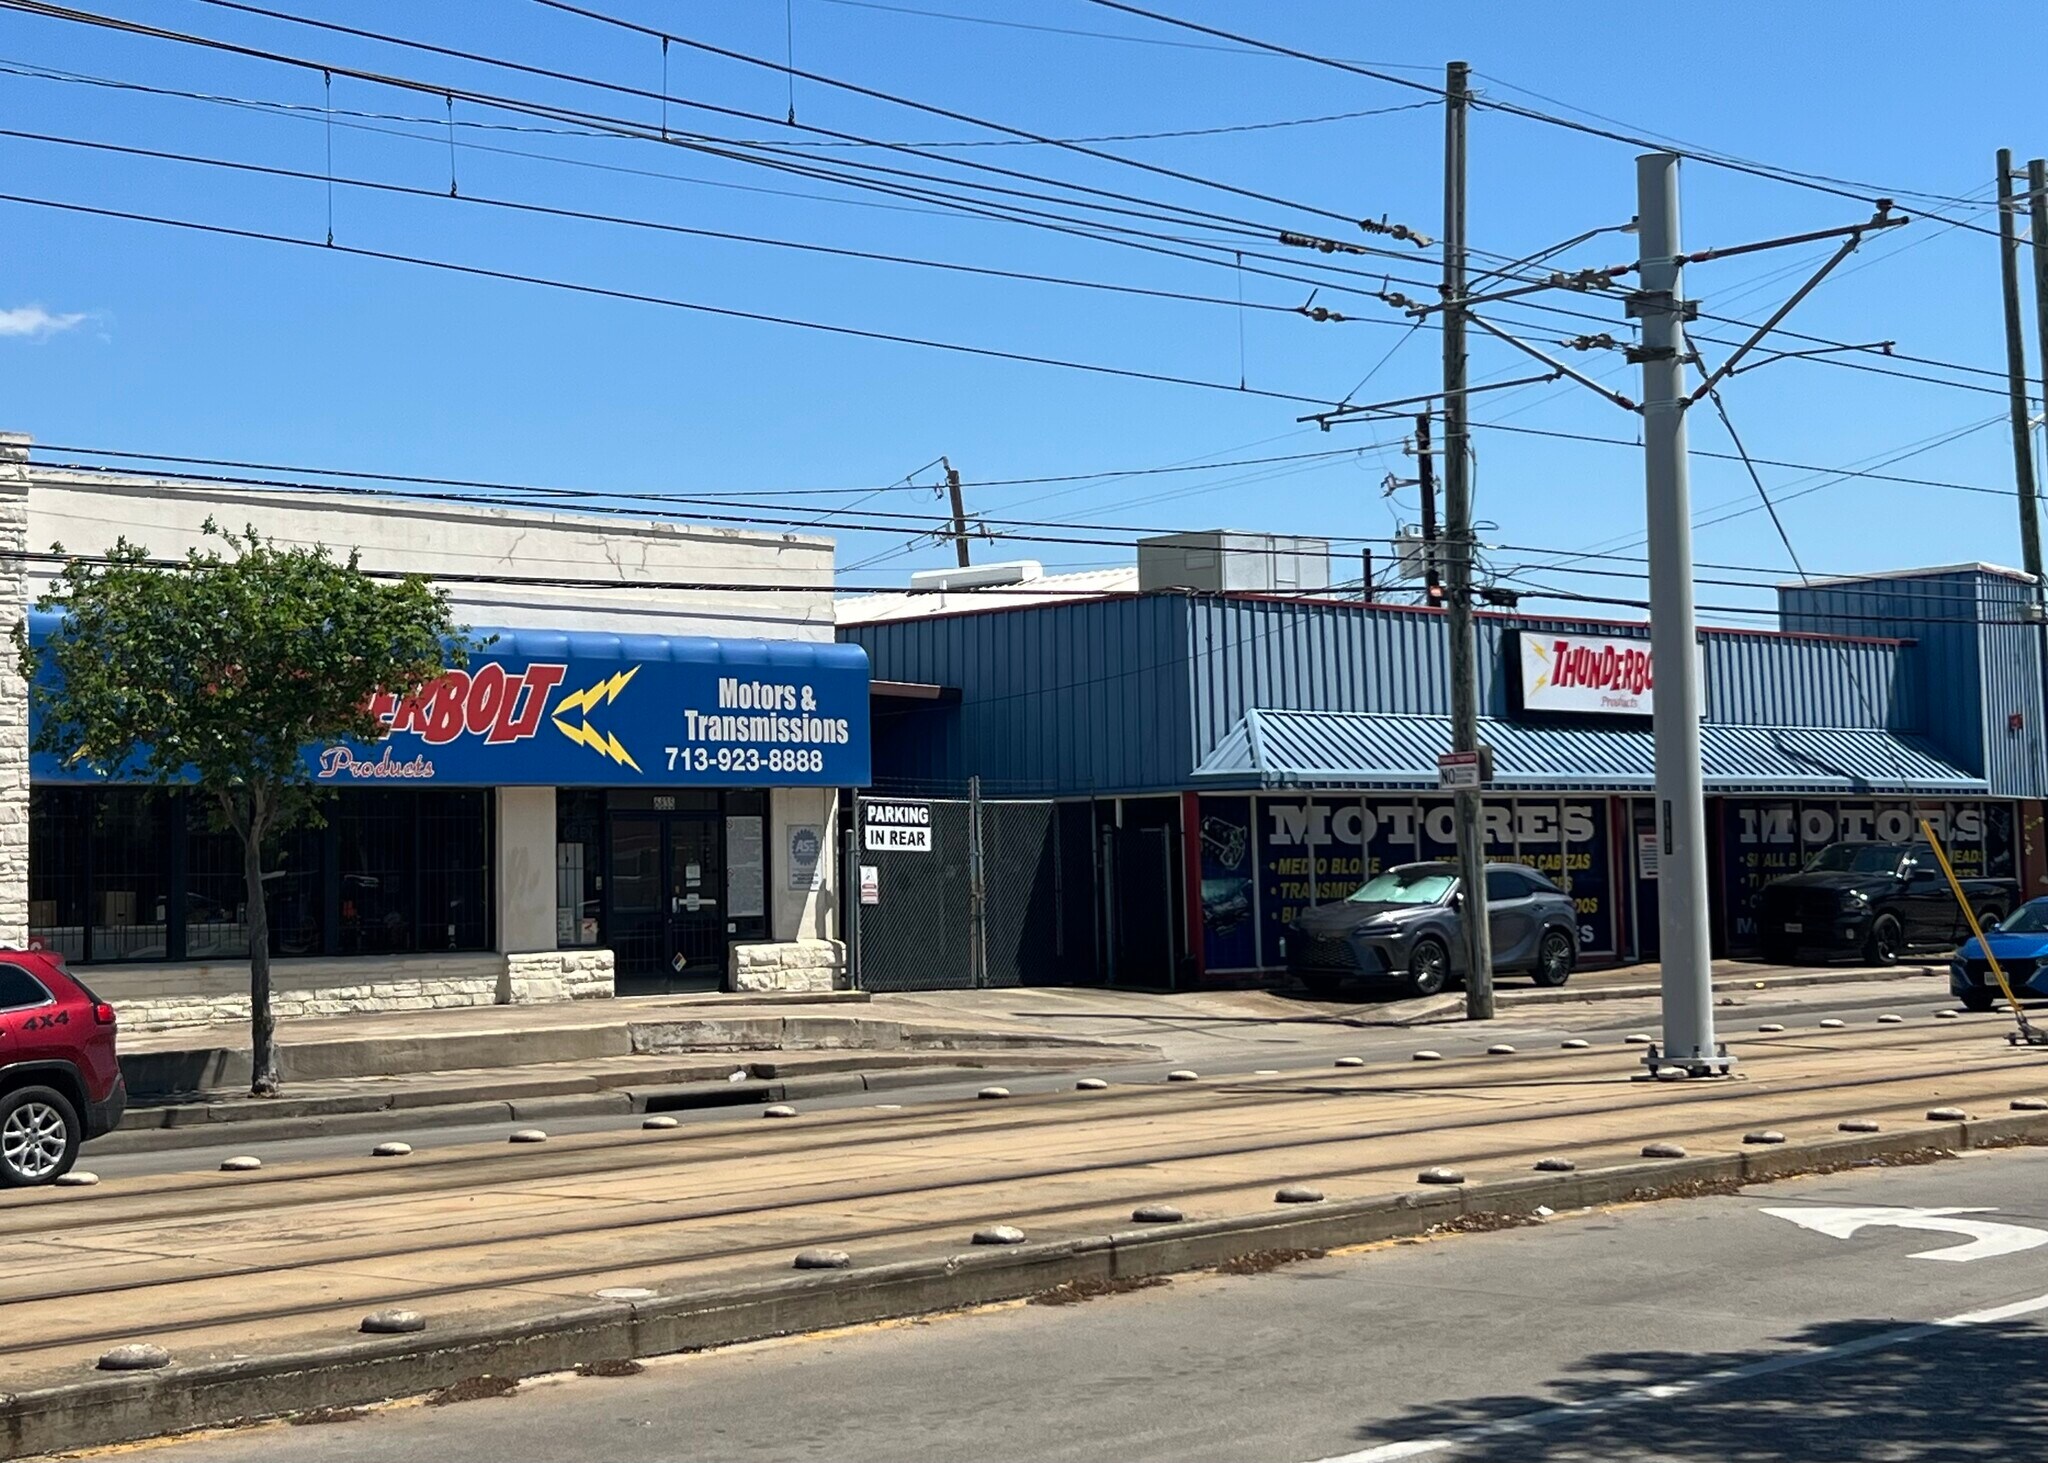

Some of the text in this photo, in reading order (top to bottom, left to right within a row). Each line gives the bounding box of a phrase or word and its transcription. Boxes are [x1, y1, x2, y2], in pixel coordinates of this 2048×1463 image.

[1551, 641, 1653, 695] THUNDERBO
[718, 678, 817, 711] Motors &
[684, 709, 849, 744] Transmissions
[317, 746, 435, 778] Products
[665, 747, 823, 773] 713-923-8888
[1441, 767, 1455, 784] NO
[867, 805, 929, 824] PARKING
[1269, 805, 1594, 845] MOTORES
[1739, 808, 1986, 844] MOTORS
[796, 840, 815, 852] ASE
[870, 830, 926, 846] IN REAR
[1278, 857, 1381, 875] MEDO BLOE
